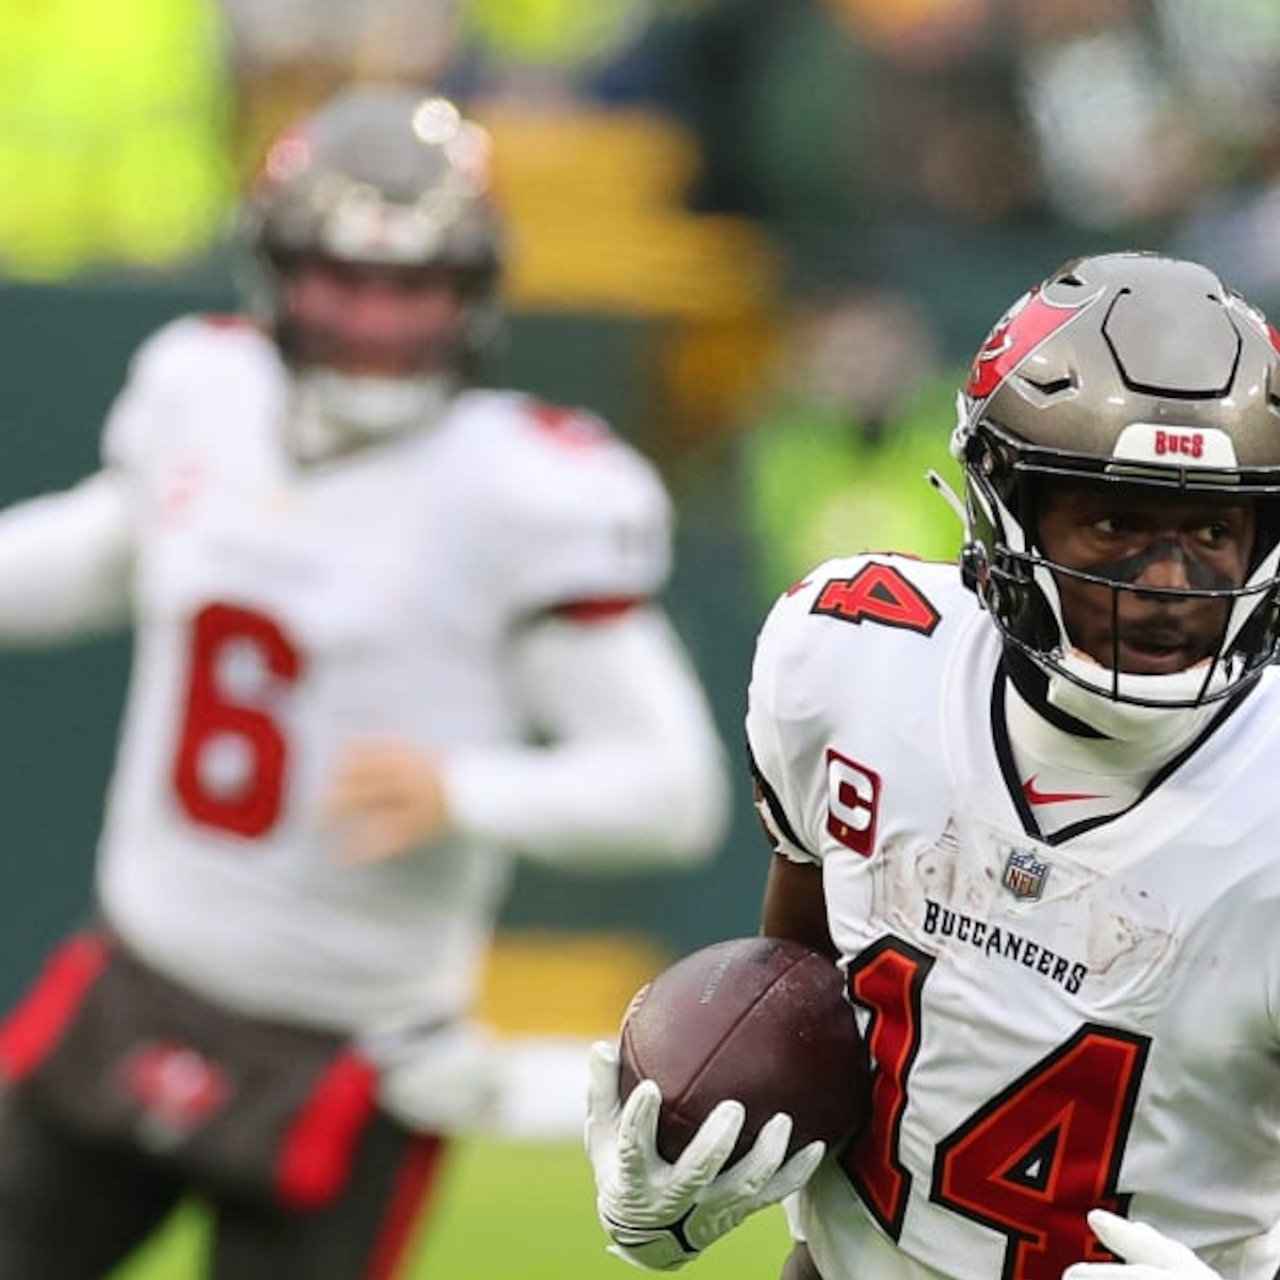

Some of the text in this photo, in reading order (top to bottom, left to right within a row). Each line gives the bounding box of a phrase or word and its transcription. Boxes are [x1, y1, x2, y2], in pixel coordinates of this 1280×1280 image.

[809, 551, 942, 638] 4
[173, 602, 304, 841] 6
[829, 759, 874, 831] C
[1007, 867, 1040, 898] NFL
[924, 898, 1088, 994] BUCCANEERS
